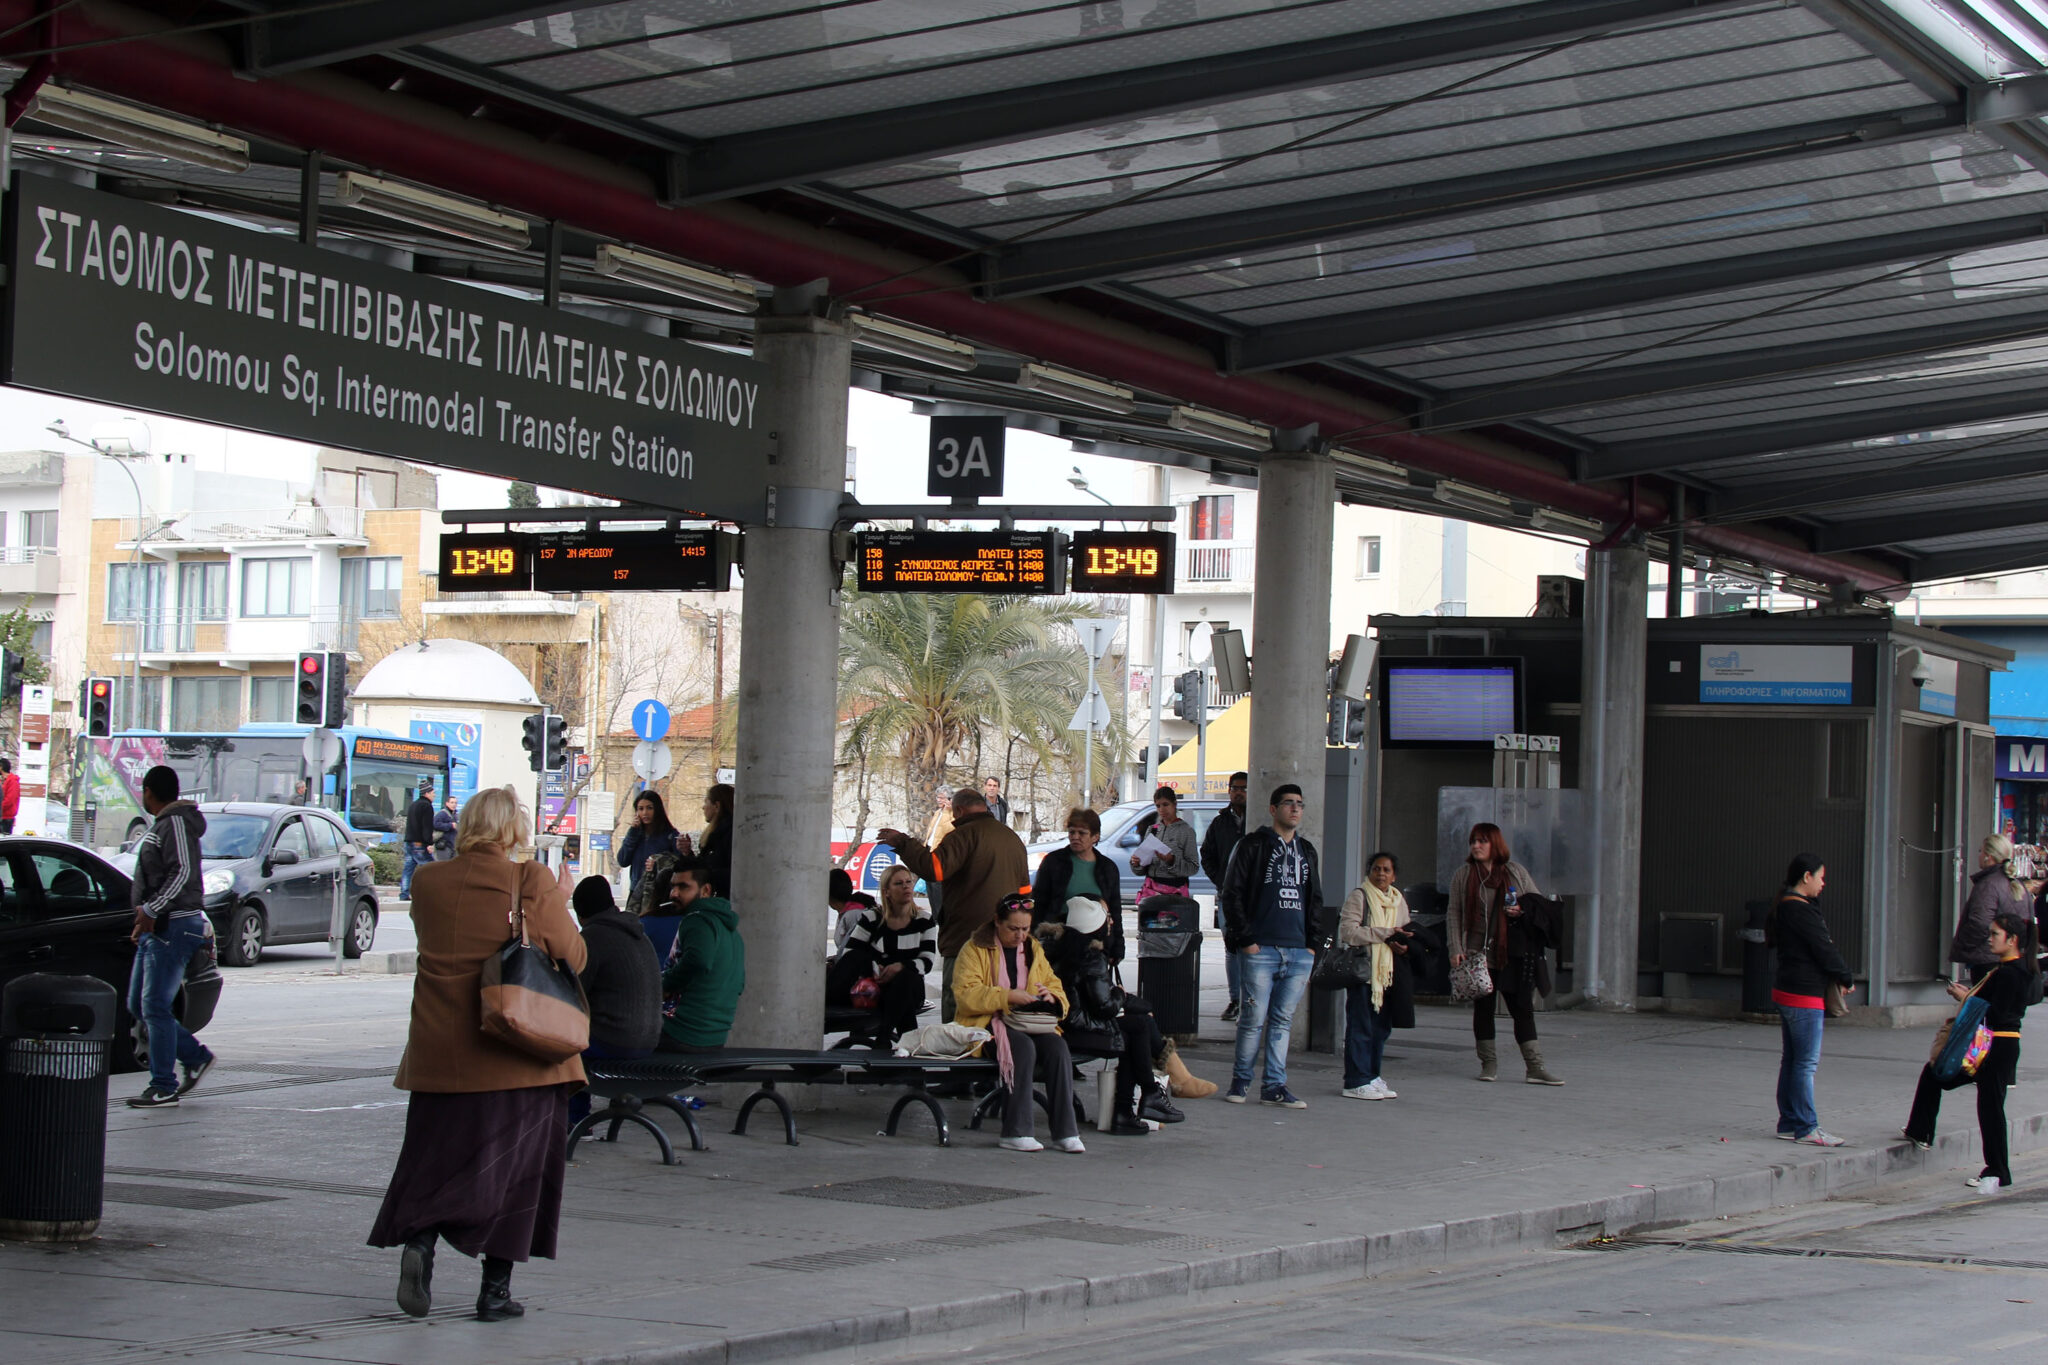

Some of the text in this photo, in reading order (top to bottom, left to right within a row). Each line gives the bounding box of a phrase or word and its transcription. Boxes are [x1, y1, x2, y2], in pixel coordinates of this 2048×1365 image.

[35, 205, 758, 430] ΣΤΑΘΜΟΣ ΜΕΤΕΠΙΒΙΒΑΣΗΣ ΠΛΑΤΕΙΑΣ ΣΟΛΩΜΟΥ
[134, 321, 693, 480] Solomou Sq. Intermodal Transfer Station
[936, 436, 991, 478] 3A
[540, 549, 556, 559] 157
[681, 546, 706, 557] 14:15
[866, 548, 883, 558] 158
[1018, 549, 1044, 559] 13:55
[451, 548, 515, 575] 13:49
[866, 559, 883, 570] 110
[1018, 560, 1044, 571] 14:00
[1087, 548, 1159, 575] 13:49
[613, 569, 629, 580] 157
[866, 571, 884, 581] 116
[895, 571, 933, 581] ΠΛΑΤΕΙΑ
[1018, 571, 1044, 582] 14:00
[1705, 686, 1772, 697] ΠΛΗΡΟΦΟΡΙΕΣ
[1781, 687, 1846, 698] INFORMATION
[410, 752, 440, 762] SQUARE
